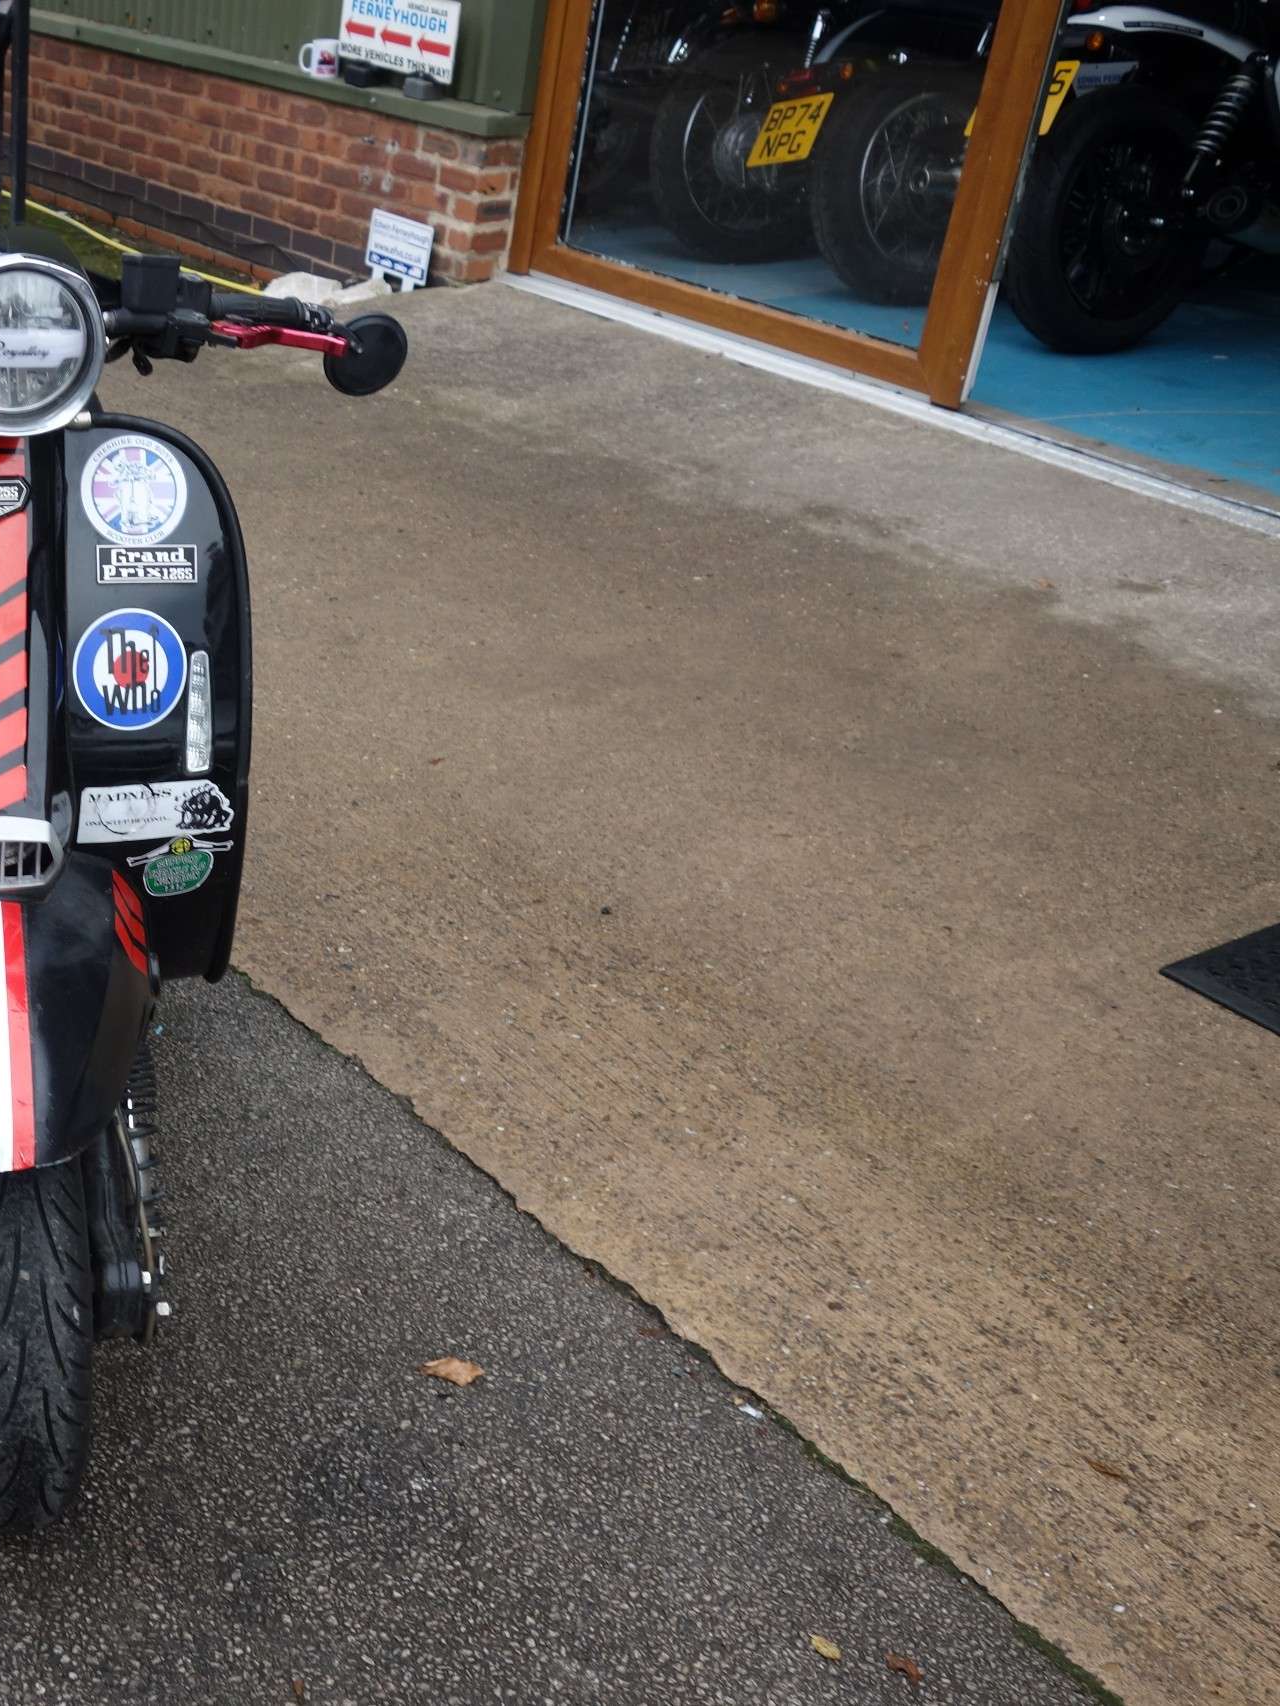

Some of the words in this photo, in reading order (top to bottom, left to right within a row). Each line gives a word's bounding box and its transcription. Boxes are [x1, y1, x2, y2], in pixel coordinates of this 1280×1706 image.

[352, 1, 448, 33] FERNEYHOUGH
[340, 42, 362, 57] MORE
[364, 48, 405, 67] VEHICLES
[406, 59, 426, 74] THIS
[763, 102, 825, 133] BP74
[759, 132, 803, 159] NPG
[111, 546, 192, 566] Grand
